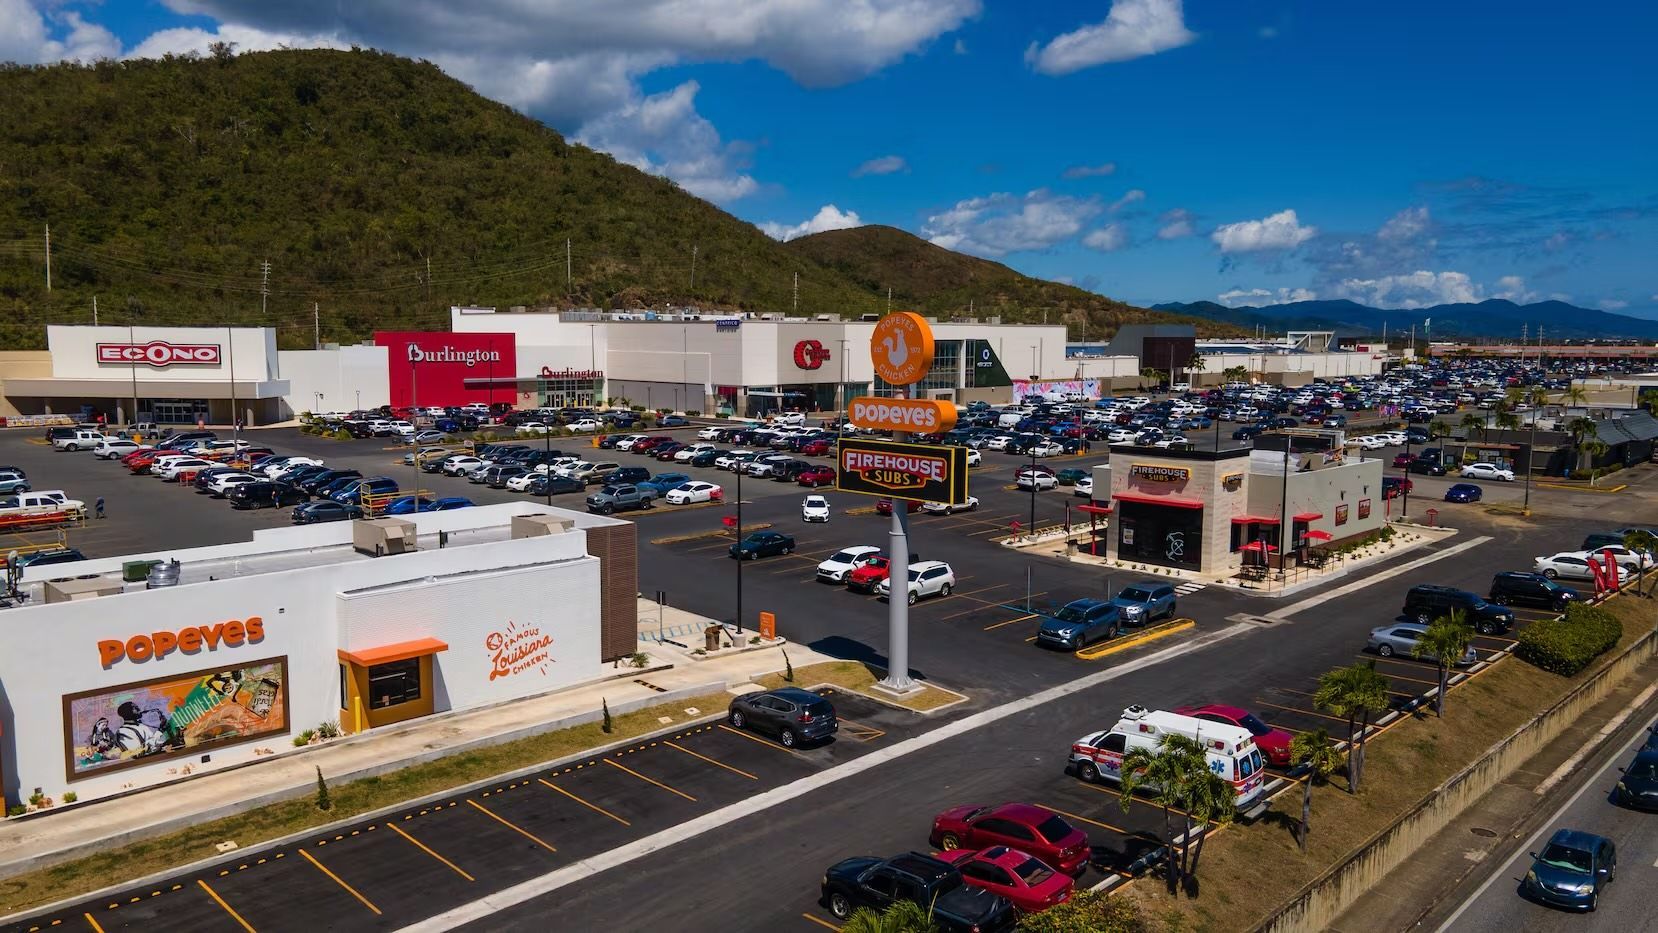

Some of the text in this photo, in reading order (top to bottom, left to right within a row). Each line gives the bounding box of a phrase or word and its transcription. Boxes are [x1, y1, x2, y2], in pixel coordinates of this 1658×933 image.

[880, 316, 915, 332] POPEYES
[102, 345, 217, 361] ECONO
[408, 344, 500, 366] Burlington
[541, 366, 604, 379] Burlington
[880, 363, 915, 380] CHICKEN
[846, 452, 943, 483] FIREHOUSE
[1131, 466, 1187, 480] FIREHOUSE
[875, 469, 911, 485] SUBS
[504, 628, 540, 650] FAMOUS
[490, 635, 553, 681] Louisiana
[513, 651, 548, 675] CHICKEN
